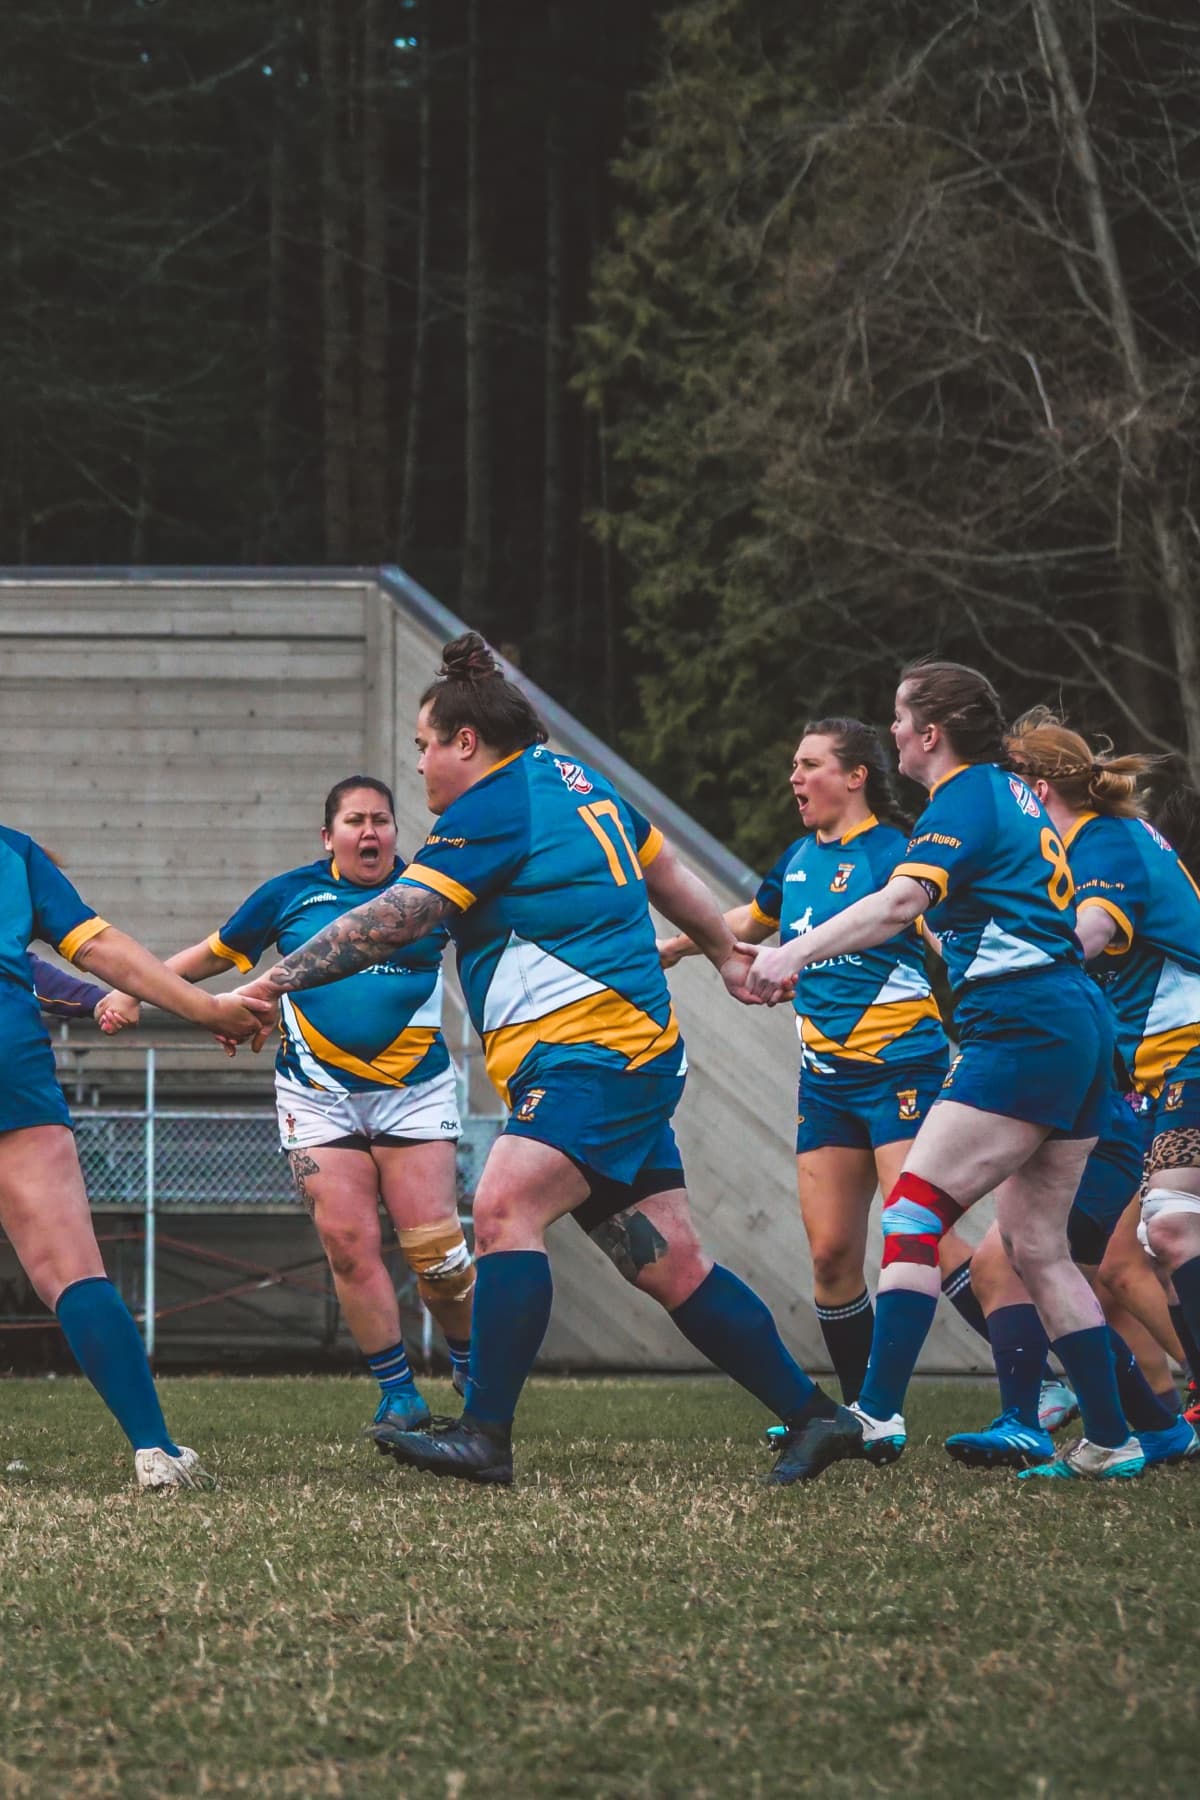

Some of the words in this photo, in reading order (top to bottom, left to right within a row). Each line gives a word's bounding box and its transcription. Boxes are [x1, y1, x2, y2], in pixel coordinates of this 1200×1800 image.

[577, 799, 643, 886] 17
[931, 832, 962, 849] RUGBY
[1040, 827, 1075, 911] 8
